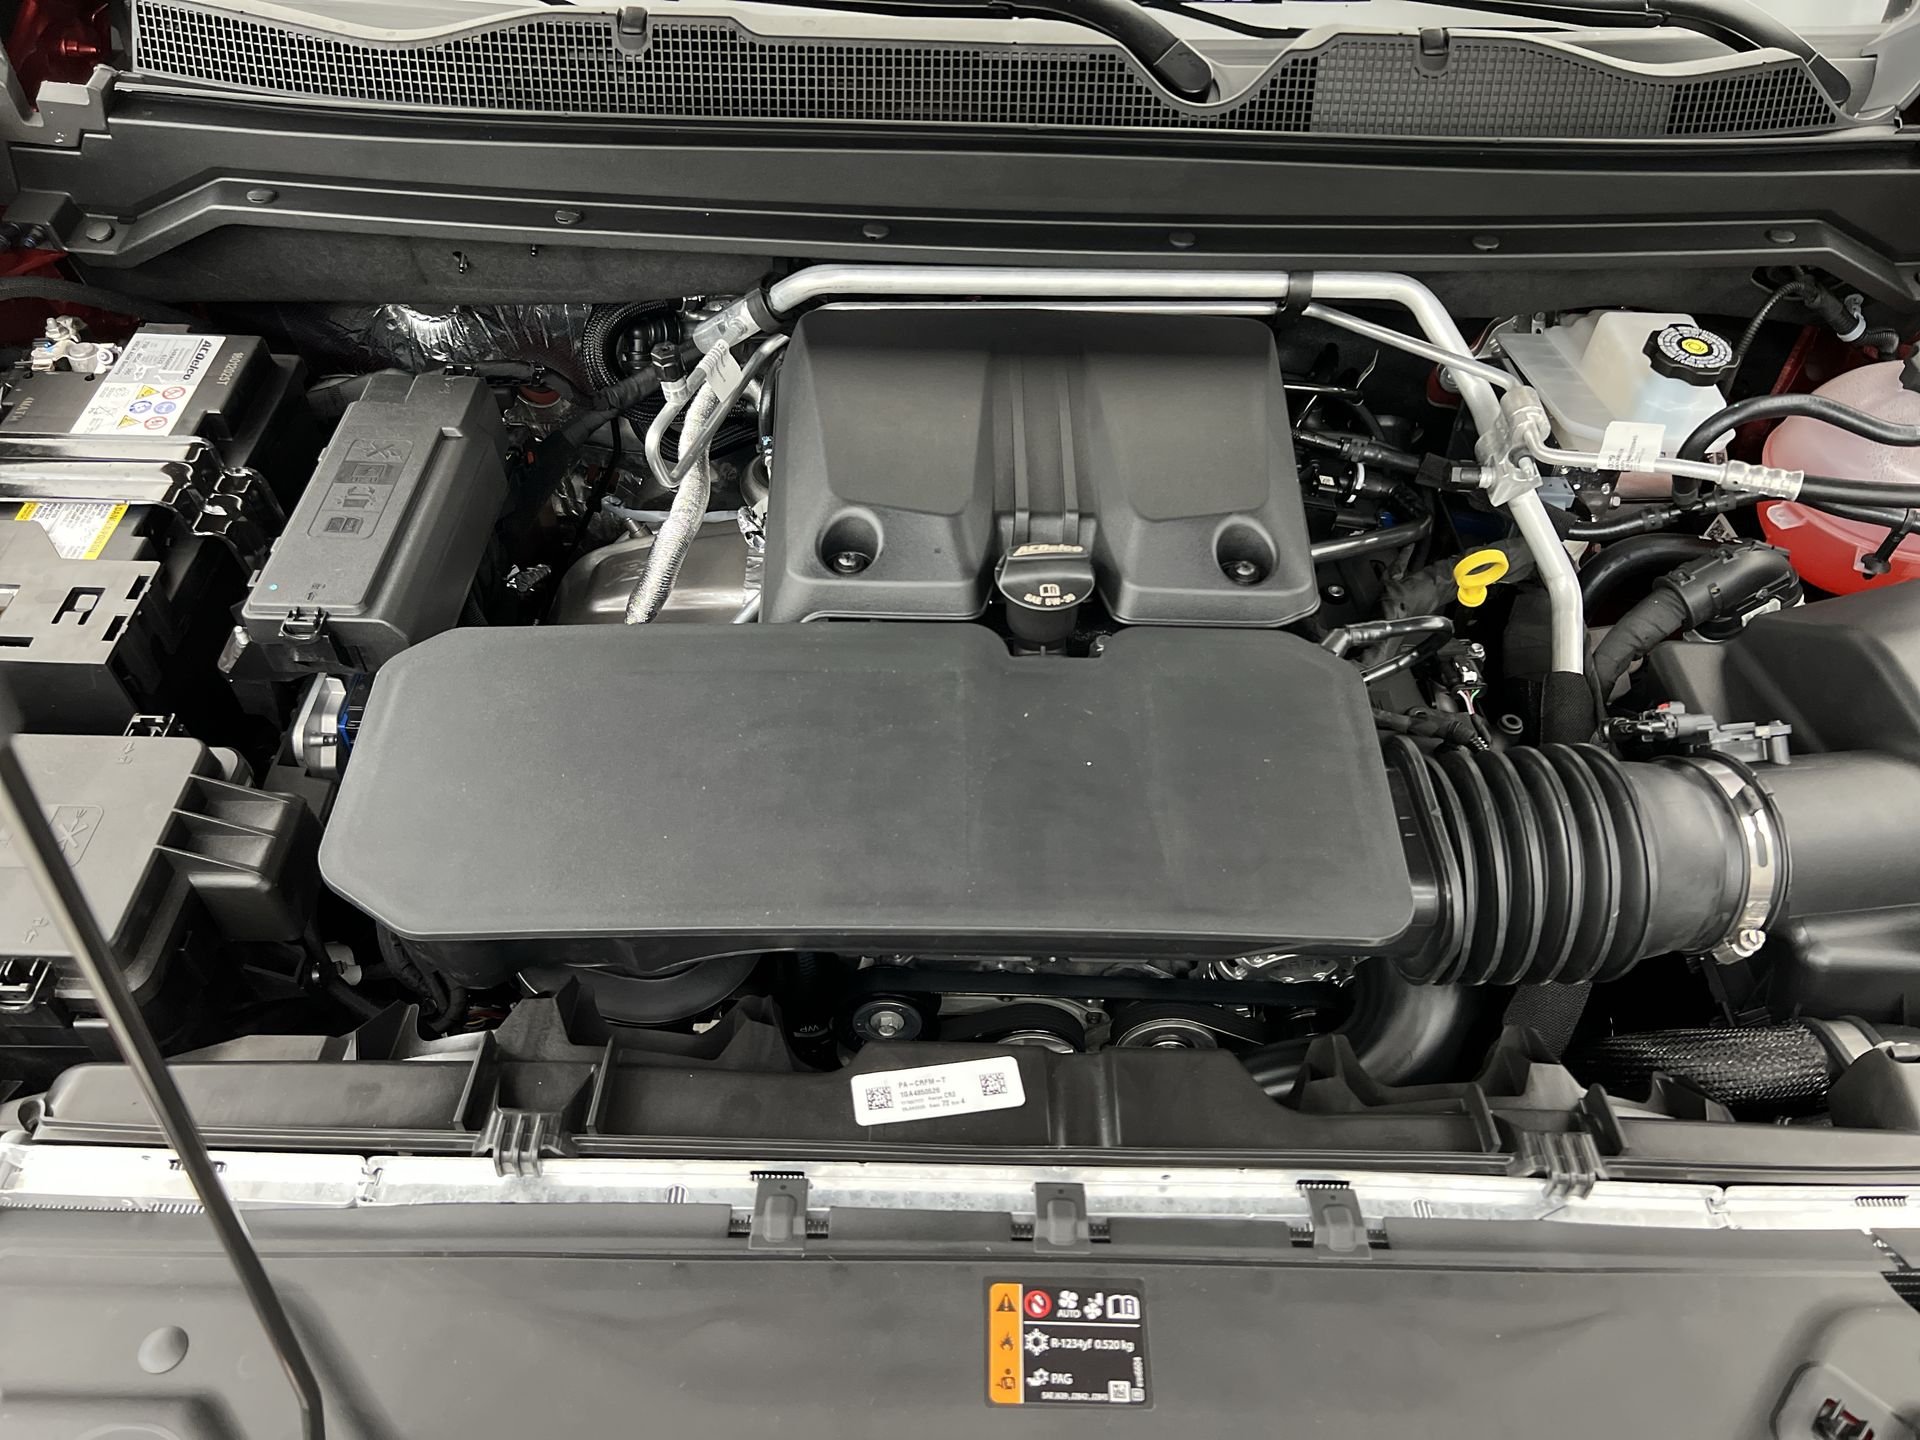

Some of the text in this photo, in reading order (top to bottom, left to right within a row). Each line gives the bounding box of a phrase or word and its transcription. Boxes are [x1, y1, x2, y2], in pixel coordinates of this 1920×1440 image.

[183, 340, 212, 380] ACDelco
[1013, 544, 1083, 556] ACDelco
[1057, 1309, 1081, 1318] AUTO
[1050, 1338, 1135, 1352] R-1234yf 0.520 kg
[1050, 1373, 1073, 1384] PAG
